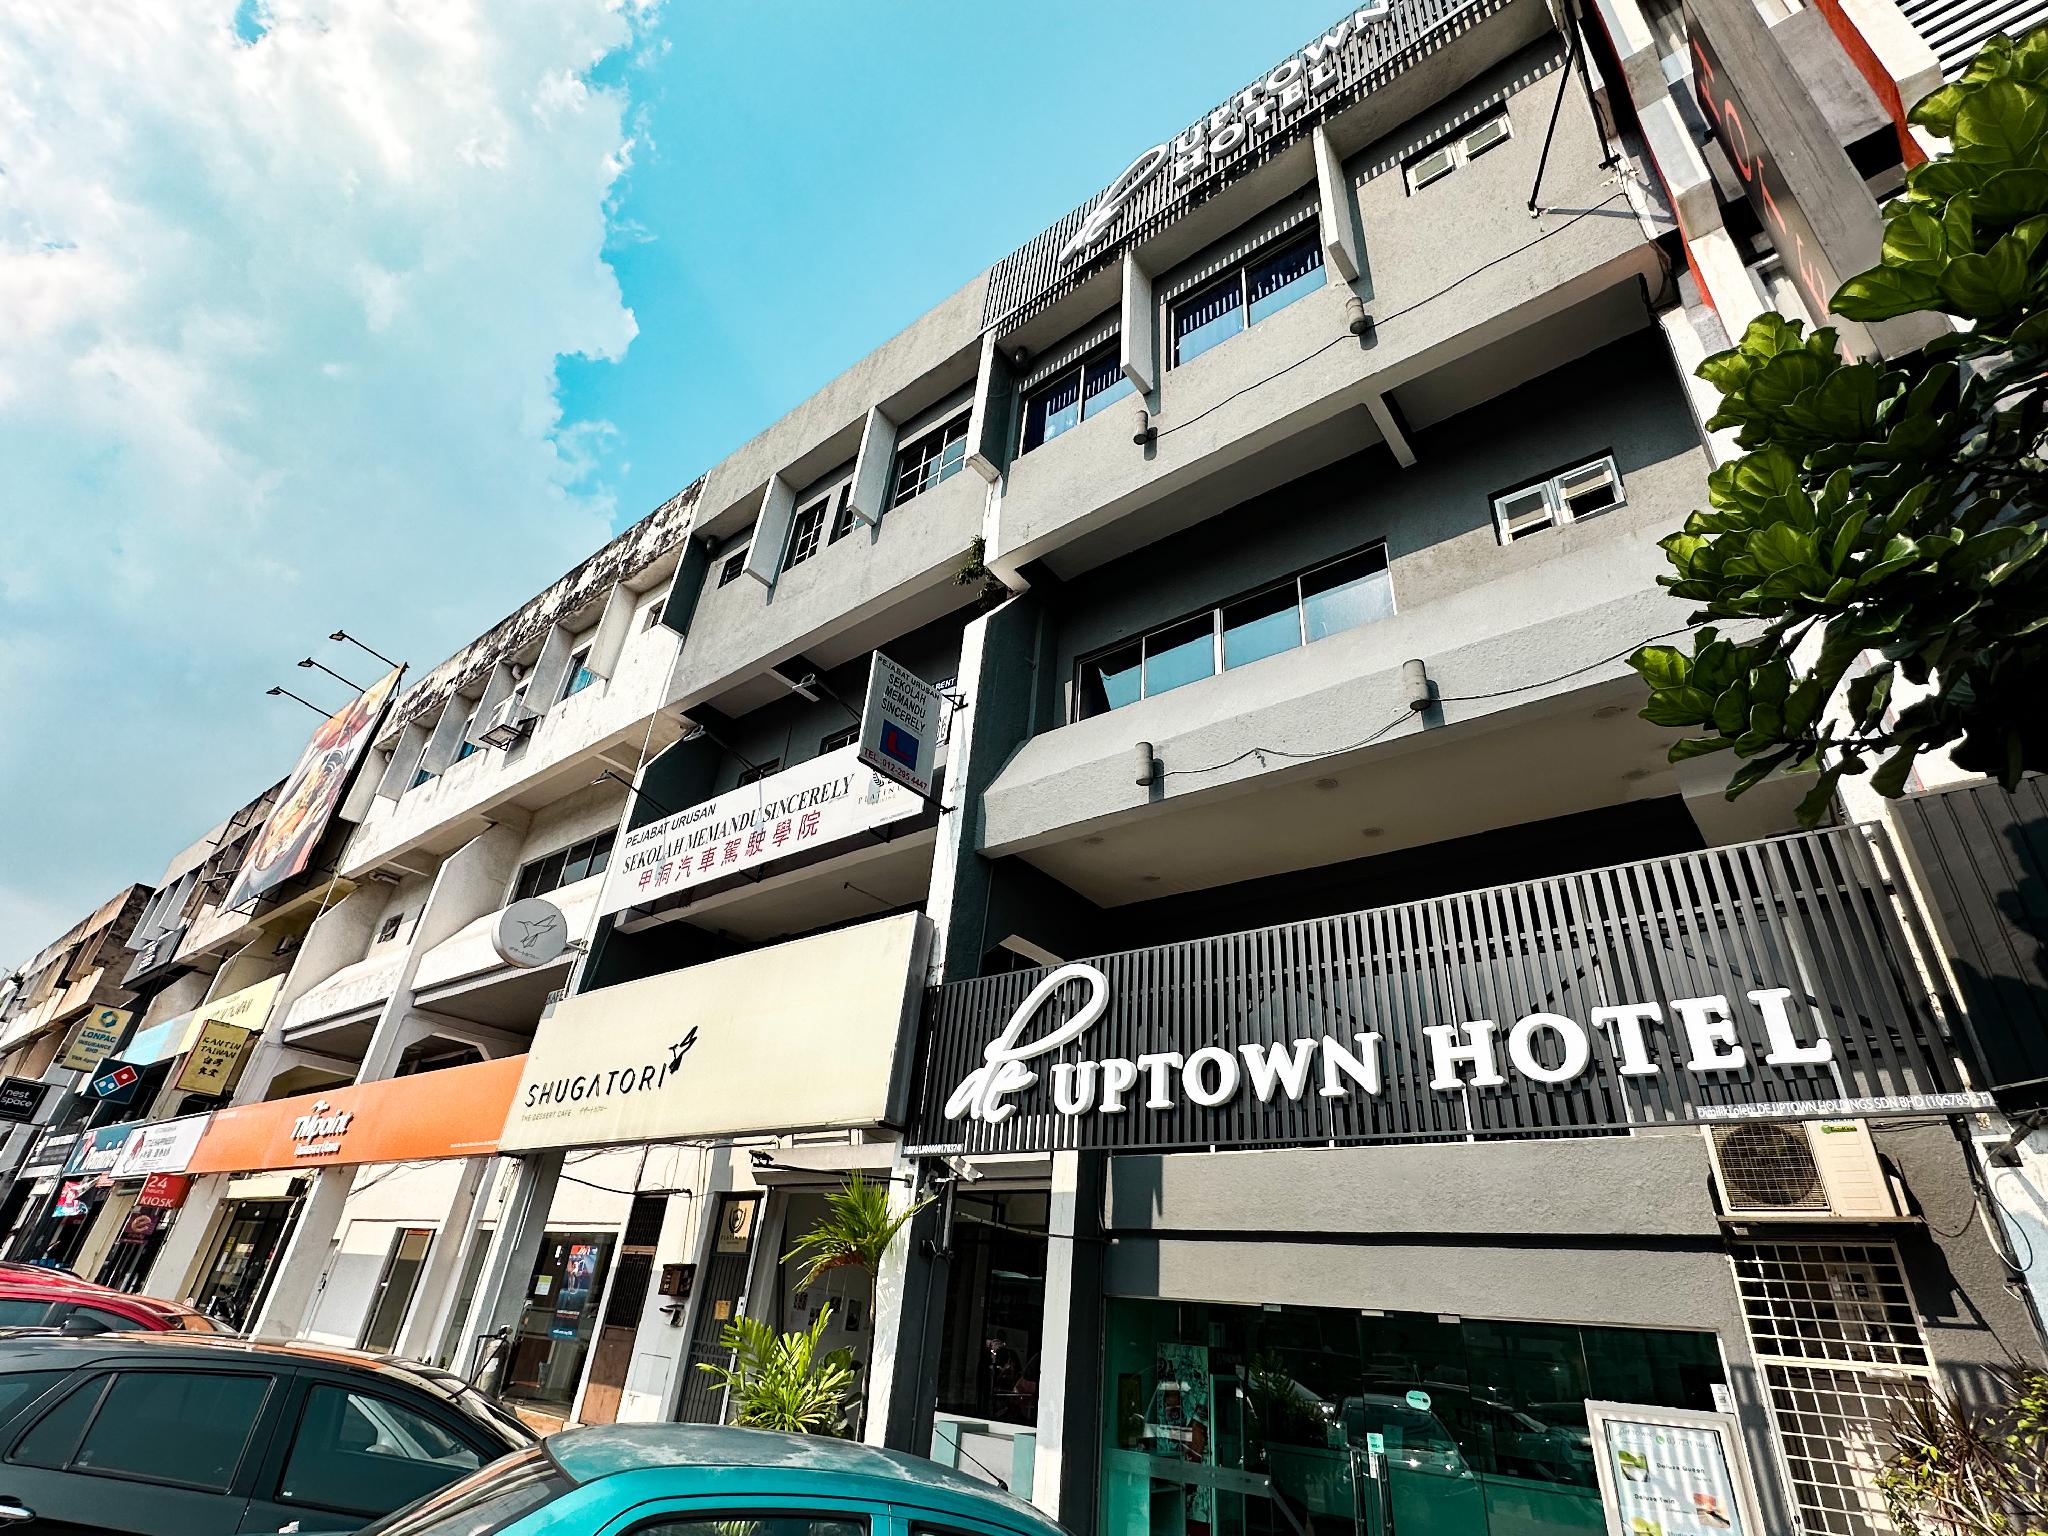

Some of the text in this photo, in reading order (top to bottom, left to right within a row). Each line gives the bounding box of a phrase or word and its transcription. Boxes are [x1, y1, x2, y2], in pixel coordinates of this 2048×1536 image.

[1175, 0, 1390, 156] UPTOWN
[1174, 62, 1338, 186] HOTEL
[878, 656, 939, 700] PEJABAT URUSAN
[888, 673, 927, 705] SEKOLAH
[881, 698, 926, 732] SINCERELY
[885, 686, 927, 718] MEMANDU
[623, 774, 856, 874] SEKOLAH MEMANDU SINCERELY
[625, 803, 716, 848] PEJABAT URUSAN
[638, 810, 821, 892] 甲洞汽車駕駛學院
[80, 1030, 117, 1043] LONPAC
[200, 1045, 237, 1058] TAIWAN
[202, 1036, 241, 1050] KANTIN
[945, 963, 1833, 1124] de UPTOWN HOTEL
[6, 1089, 30, 1099] nest
[525, 1063, 667, 1107] SHUGATORI
[1, 1096, 33, 1107] space
[1772, 1102, 1816, 1113] UPTOWN
[1818, 1099, 1873, 1111] HOLDINGS
[1875, 1097, 1898, 1109] SDN
[1899, 1095, 1924, 1107] BHD
[148, 1176, 168, 1190] 24
[140, 1195, 174, 1208] KIOSK
